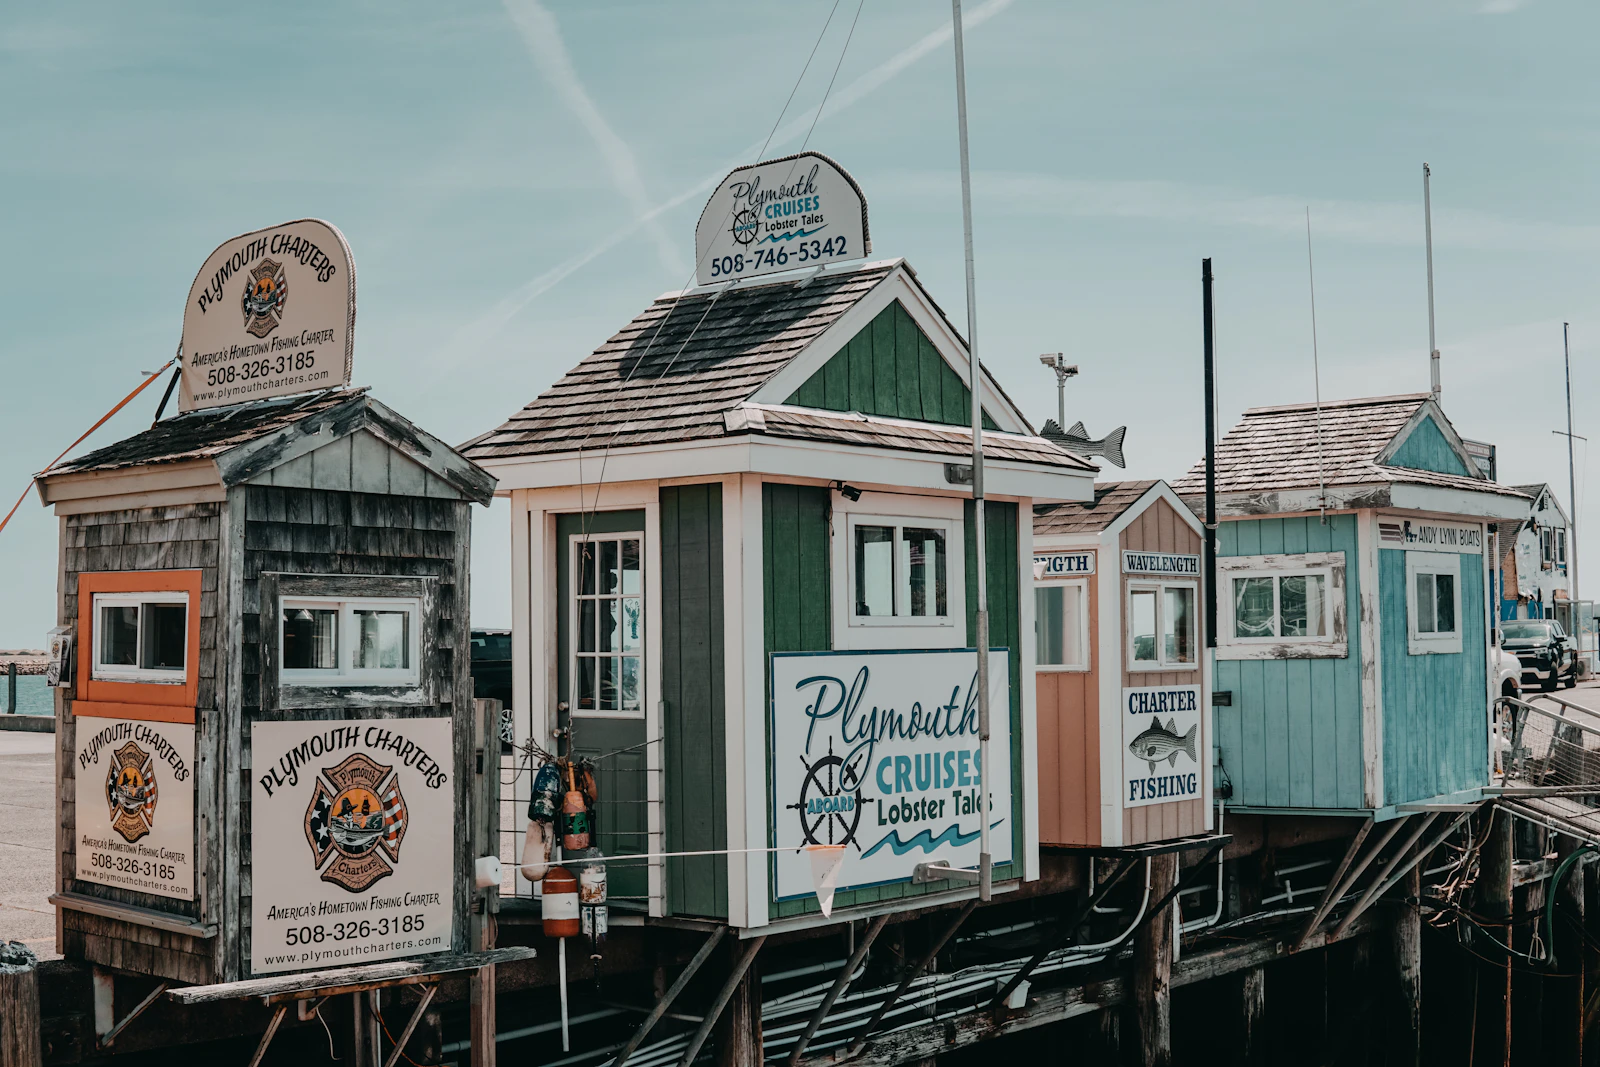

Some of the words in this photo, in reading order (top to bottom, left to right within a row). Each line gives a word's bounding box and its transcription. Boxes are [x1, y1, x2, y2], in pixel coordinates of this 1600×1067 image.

[729, 163, 819, 222] Plymouth
[765, 195, 820, 219] CRUISES
[765, 217, 798, 232] Lobster
[801, 213, 824, 226] Tales
[711, 235, 847, 277] 508-746-5342
[197, 236, 268, 314] PLYMOUTH
[270, 233, 336, 283] CHARTERS
[229, 341, 271, 361] HOMETOWN
[271, 336, 299, 352] FISHING
[300, 329, 335, 346] CHARTER
[207, 350, 315, 386] 508-326-3185
[193, 370, 329, 401] www.plymouthcharters.com
[1418, 526, 1438, 544] ANDY
[1440, 527, 1457, 545] LYNN
[1460, 529, 1481, 547] BOATS
[1126, 554, 1197, 573] WAVELENGTH
[1128, 690, 1197, 715] CHARTER
[796, 665, 979, 792] Plymouth
[79, 722, 132, 770] PLYMOUTH
[134, 724, 190, 782] CHARTERS
[259, 726, 360, 798] PLYMOUTH
[364, 726, 448, 789] CHARTERS
[339, 766, 377, 786] Plymouth
[1129, 773, 1197, 801] FISHING
[806, 795, 855, 815] ABOARD
[877, 796, 945, 826] Lobster
[91, 852, 175, 880] 508-326-3185
[138, 844, 159, 858] FISHING
[160, 847, 187, 864] CHARTER
[338, 858, 378, 876] Charters
[81, 868, 188, 895] www.plymouthcharters.com
[267, 903, 316, 921] AMERICA'S
[318, 898, 368, 916] HOMETOWN
[370, 895, 402, 910] FISHING
[404, 892, 441, 907] CHARTER
[285, 914, 425, 946] 508-326-3185
[264, 936, 442, 965] www.plymouthcharters.com
